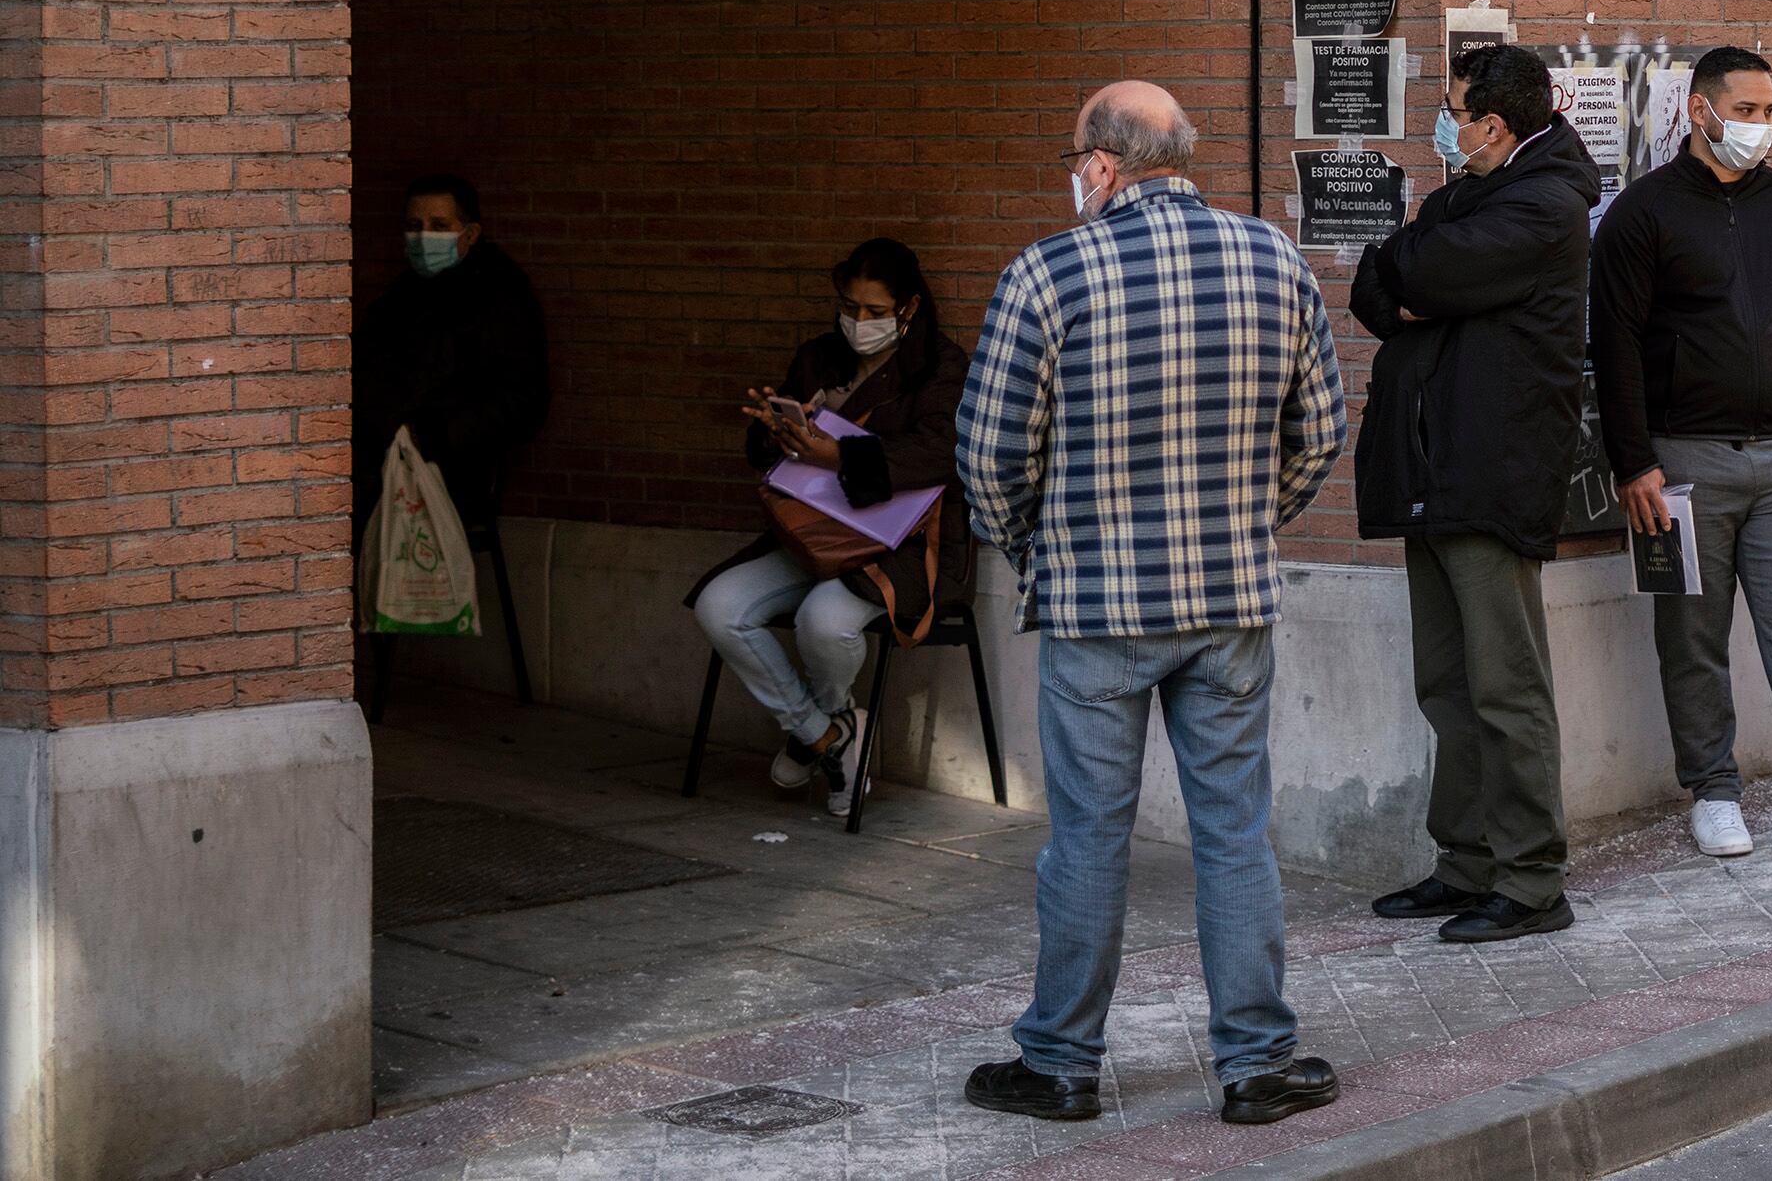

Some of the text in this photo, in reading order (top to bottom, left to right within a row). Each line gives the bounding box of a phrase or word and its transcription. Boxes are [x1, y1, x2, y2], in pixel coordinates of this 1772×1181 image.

[1305, 2, 1336, 11] Contactar
[1304, 12, 1320, 20] para
[1314, 45, 1389, 55] TEST DE FARMACIA
[1332, 57, 1370, 66] POSITIVO
[1329, 69, 1338, 77] Ya
[1348, 70, 1374, 80] precisa
[1328, 78, 1373, 87] confirmación
[1577, 77, 1616, 87] EXIGIMOS
[1577, 101, 1617, 110] PERSONAL
[1574, 116, 1618, 126] SANITARIO
[1665, 118, 1670, 126] 8
[1683, 124, 1687, 133] 5
[1321, 152, 1379, 164] CONTACTO
[1311, 167, 1389, 178] ESTRECHO CON
[1327, 181, 1373, 193] POSITIVO
[1314, 197, 1393, 211] No Vacunado
[1310, 217, 1343, 225] Cuarentena
